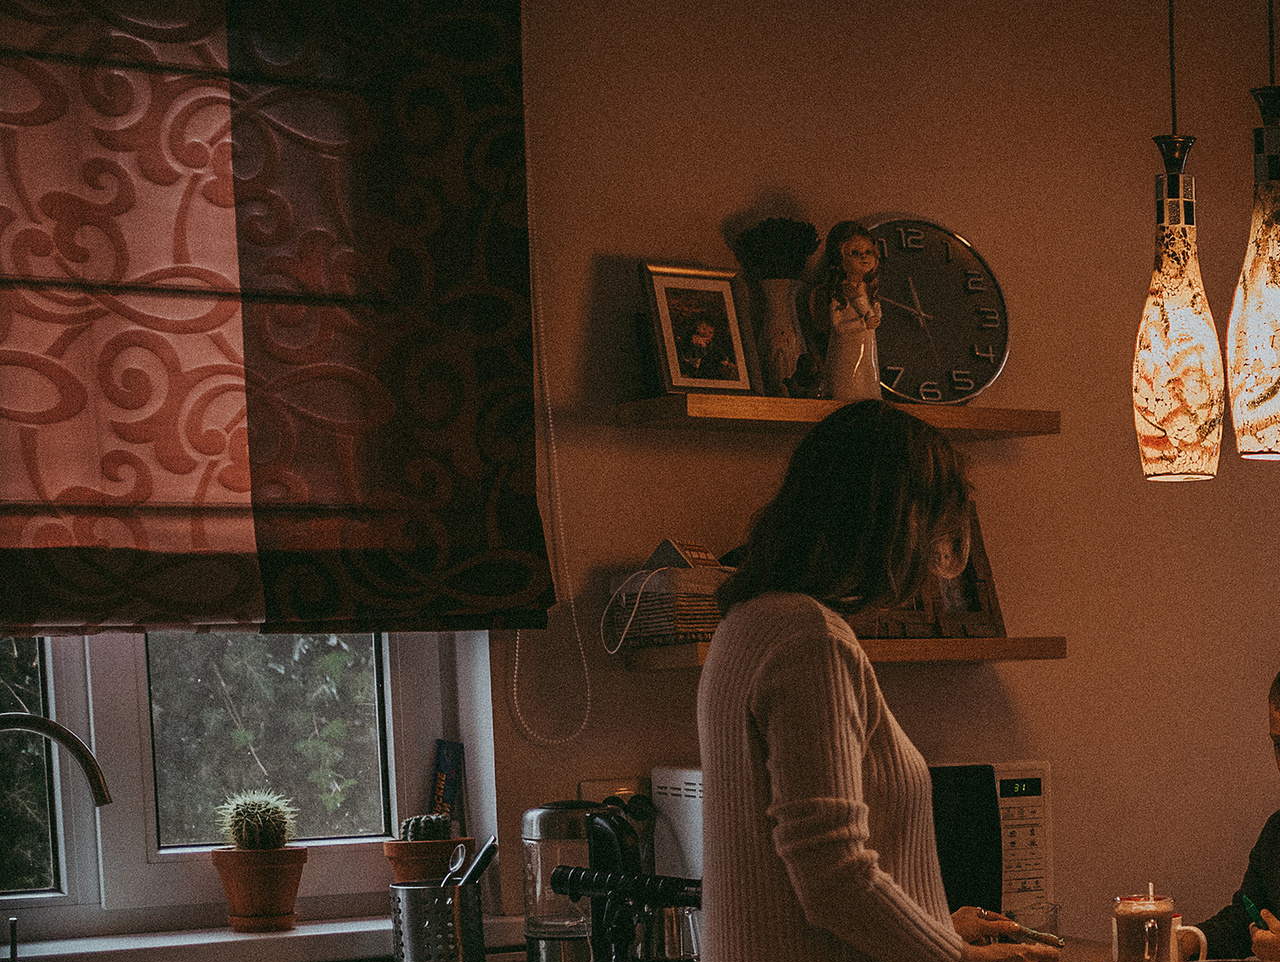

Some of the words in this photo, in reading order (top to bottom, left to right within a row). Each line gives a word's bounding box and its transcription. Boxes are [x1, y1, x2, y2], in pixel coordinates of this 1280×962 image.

[896, 228, 925, 249] 12
[942, 240, 953, 260] 1
[965, 270, 985, 290] 2
[981, 307, 1000, 328] 3
[974, 343, 995, 364] 4
[887, 366, 905, 389] 7
[952, 370, 975, 391] 5
[919, 381, 942, 401] 6
[433, 771, 446, 815] ЬСКИЕ
